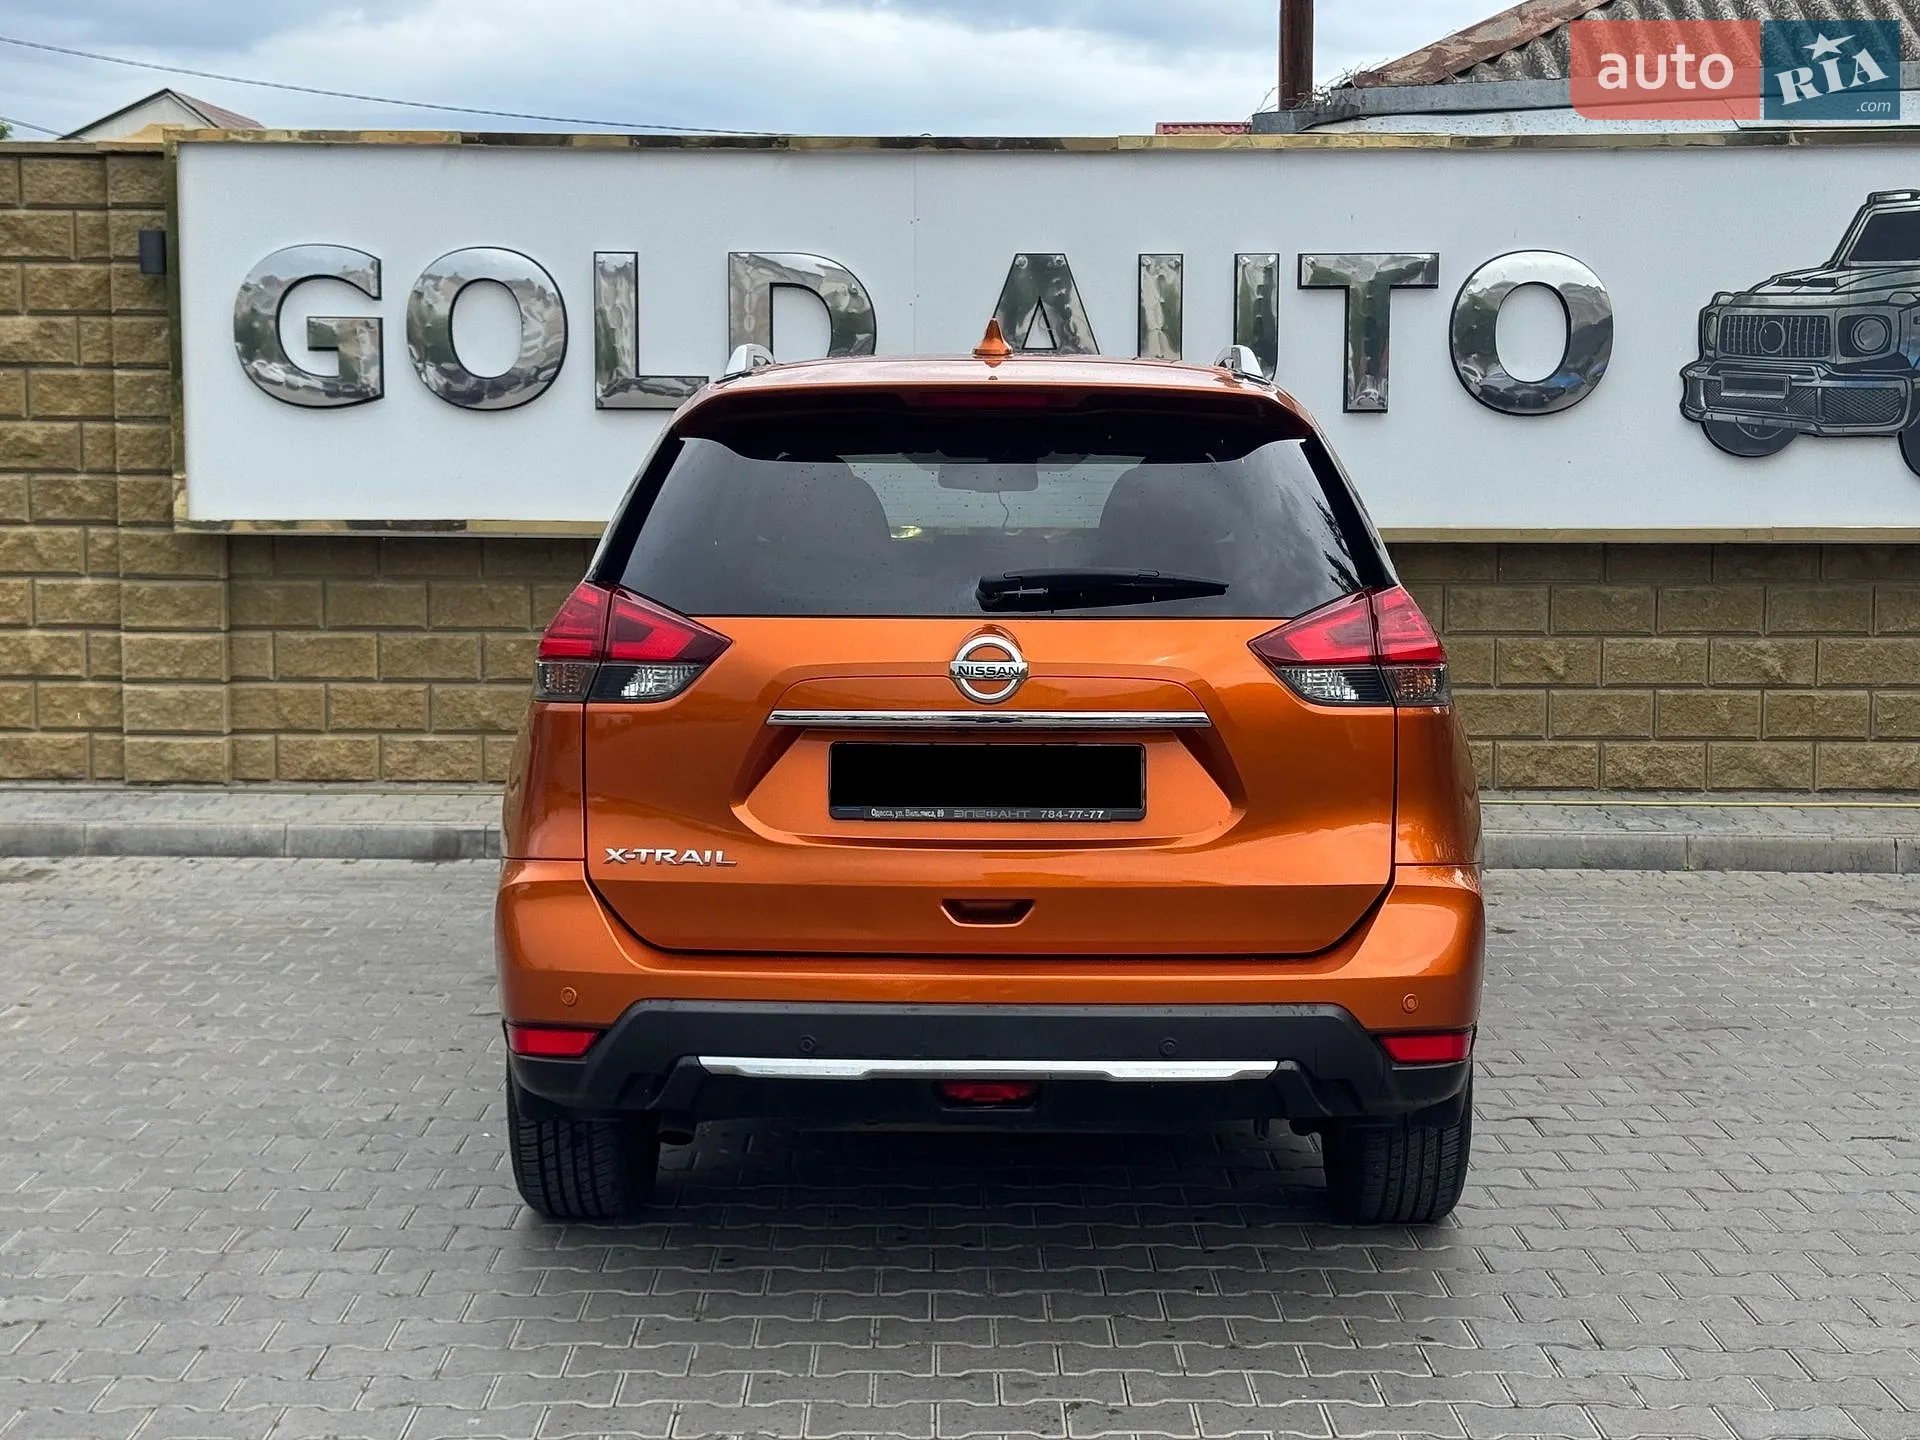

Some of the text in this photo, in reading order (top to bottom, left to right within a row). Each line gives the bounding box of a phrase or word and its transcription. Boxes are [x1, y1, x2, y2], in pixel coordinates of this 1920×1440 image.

[233, 244, 1614, 416] GOLD AUTO
[957, 665, 1019, 676] NISSAN
[1040, 810, 1105, 819] 784-77-77
[603, 848, 737, 866] X-TRAIL
